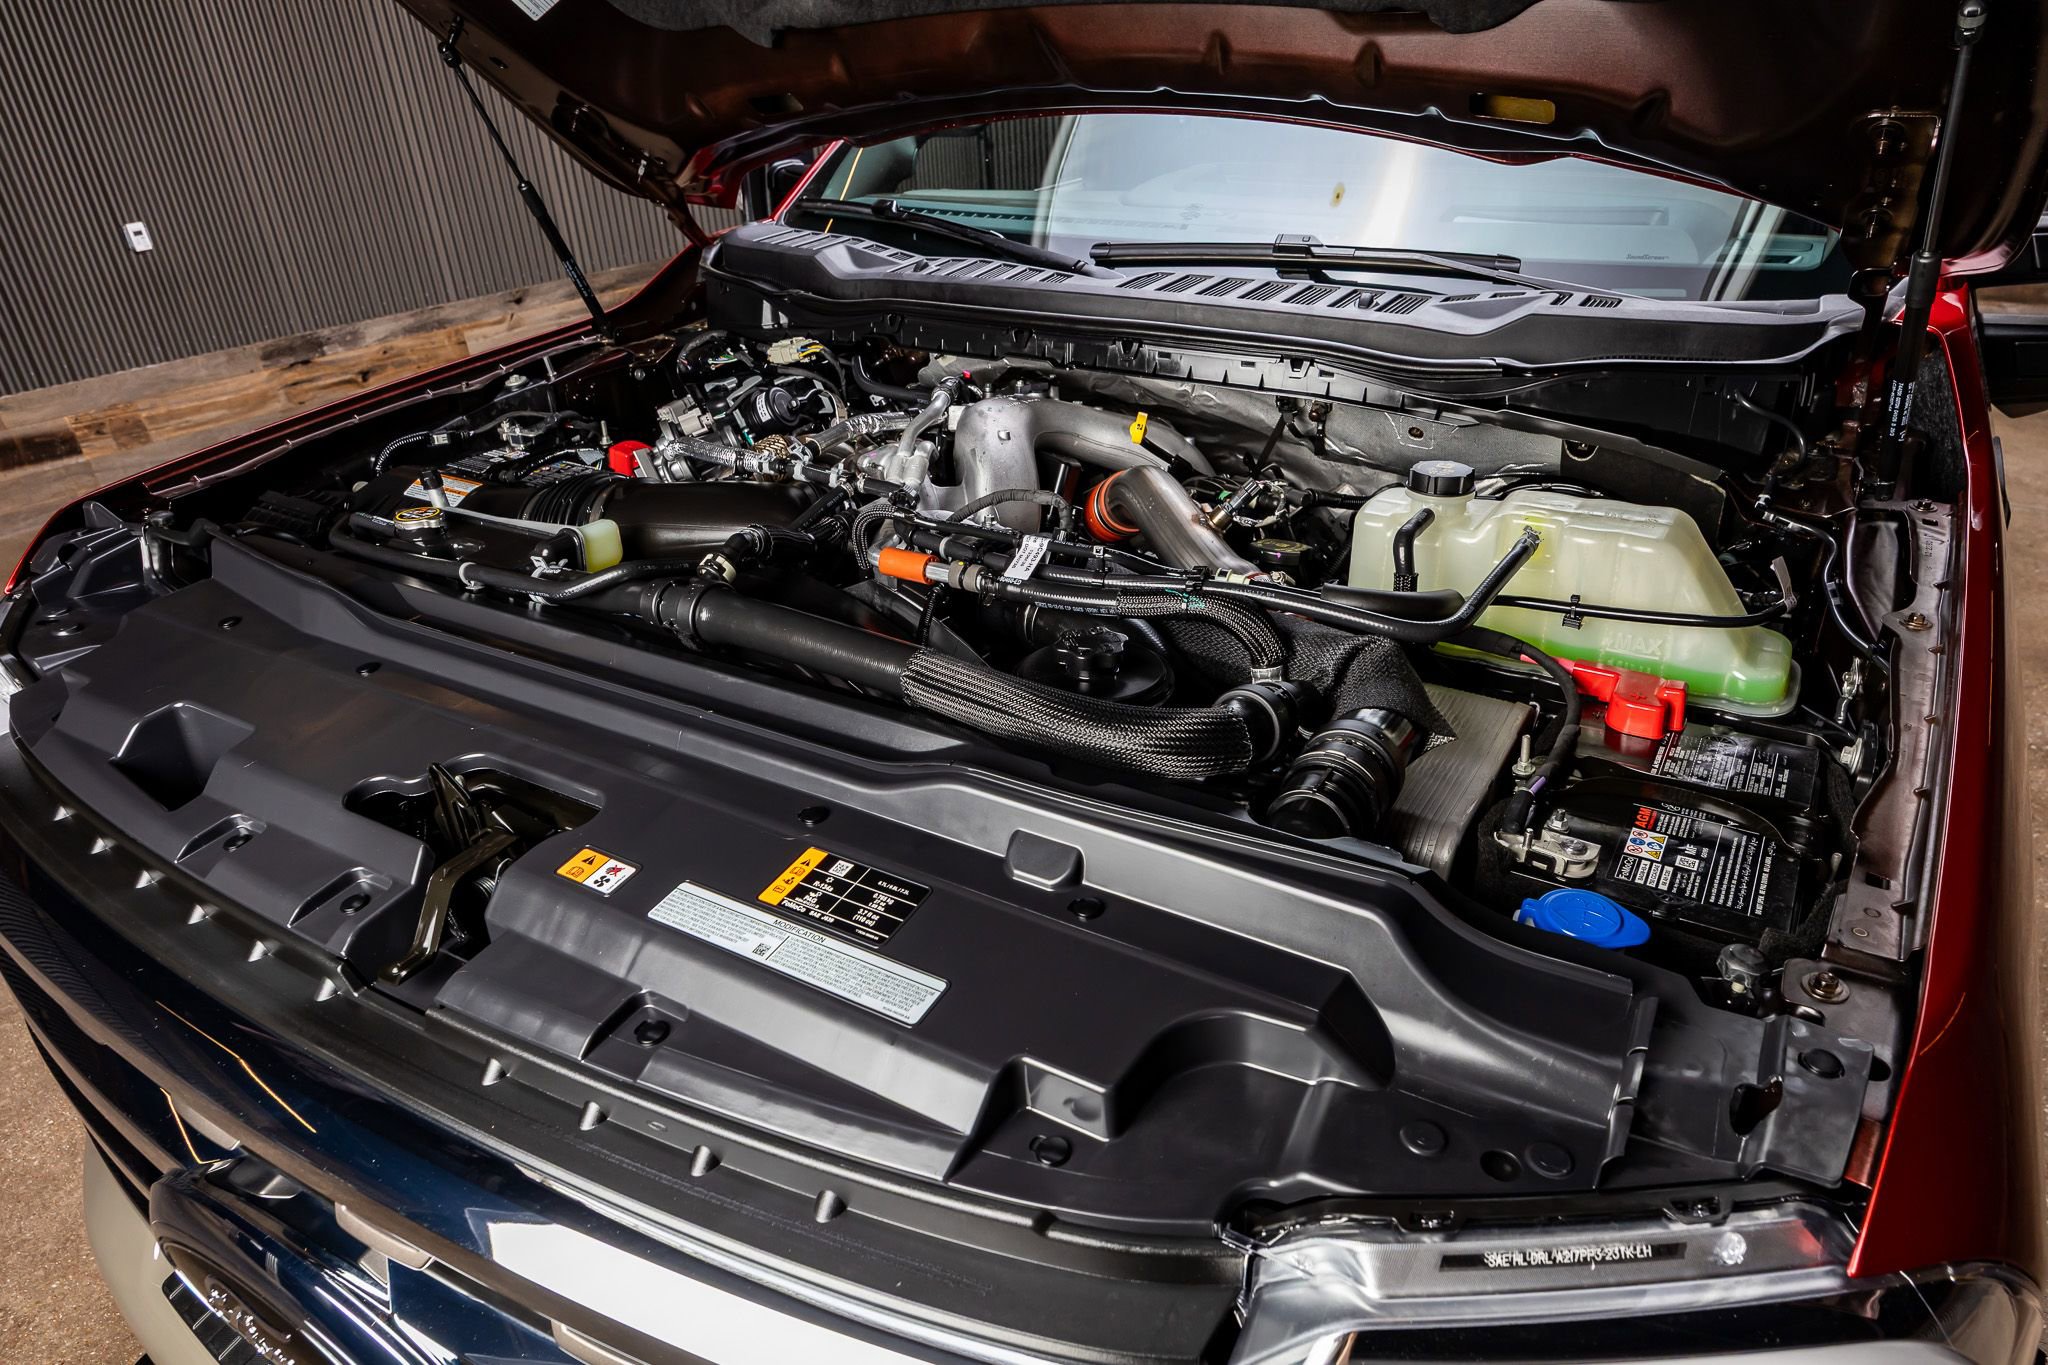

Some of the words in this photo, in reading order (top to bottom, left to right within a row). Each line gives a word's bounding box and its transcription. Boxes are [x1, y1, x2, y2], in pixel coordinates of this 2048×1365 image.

[1616, 632, 1663, 655] MAX
[1634, 807, 1652, 829] AGM
[1619, 857, 1634, 880] FoMoCo
[813, 880, 834, 892] R-134a
[781, 900, 806, 912] FoMoCo
[772, 919, 826, 943] MODIFICATION
[1488, 1254, 1511, 1267] SAE
[1531, 1252, 1553, 1265] DRL
